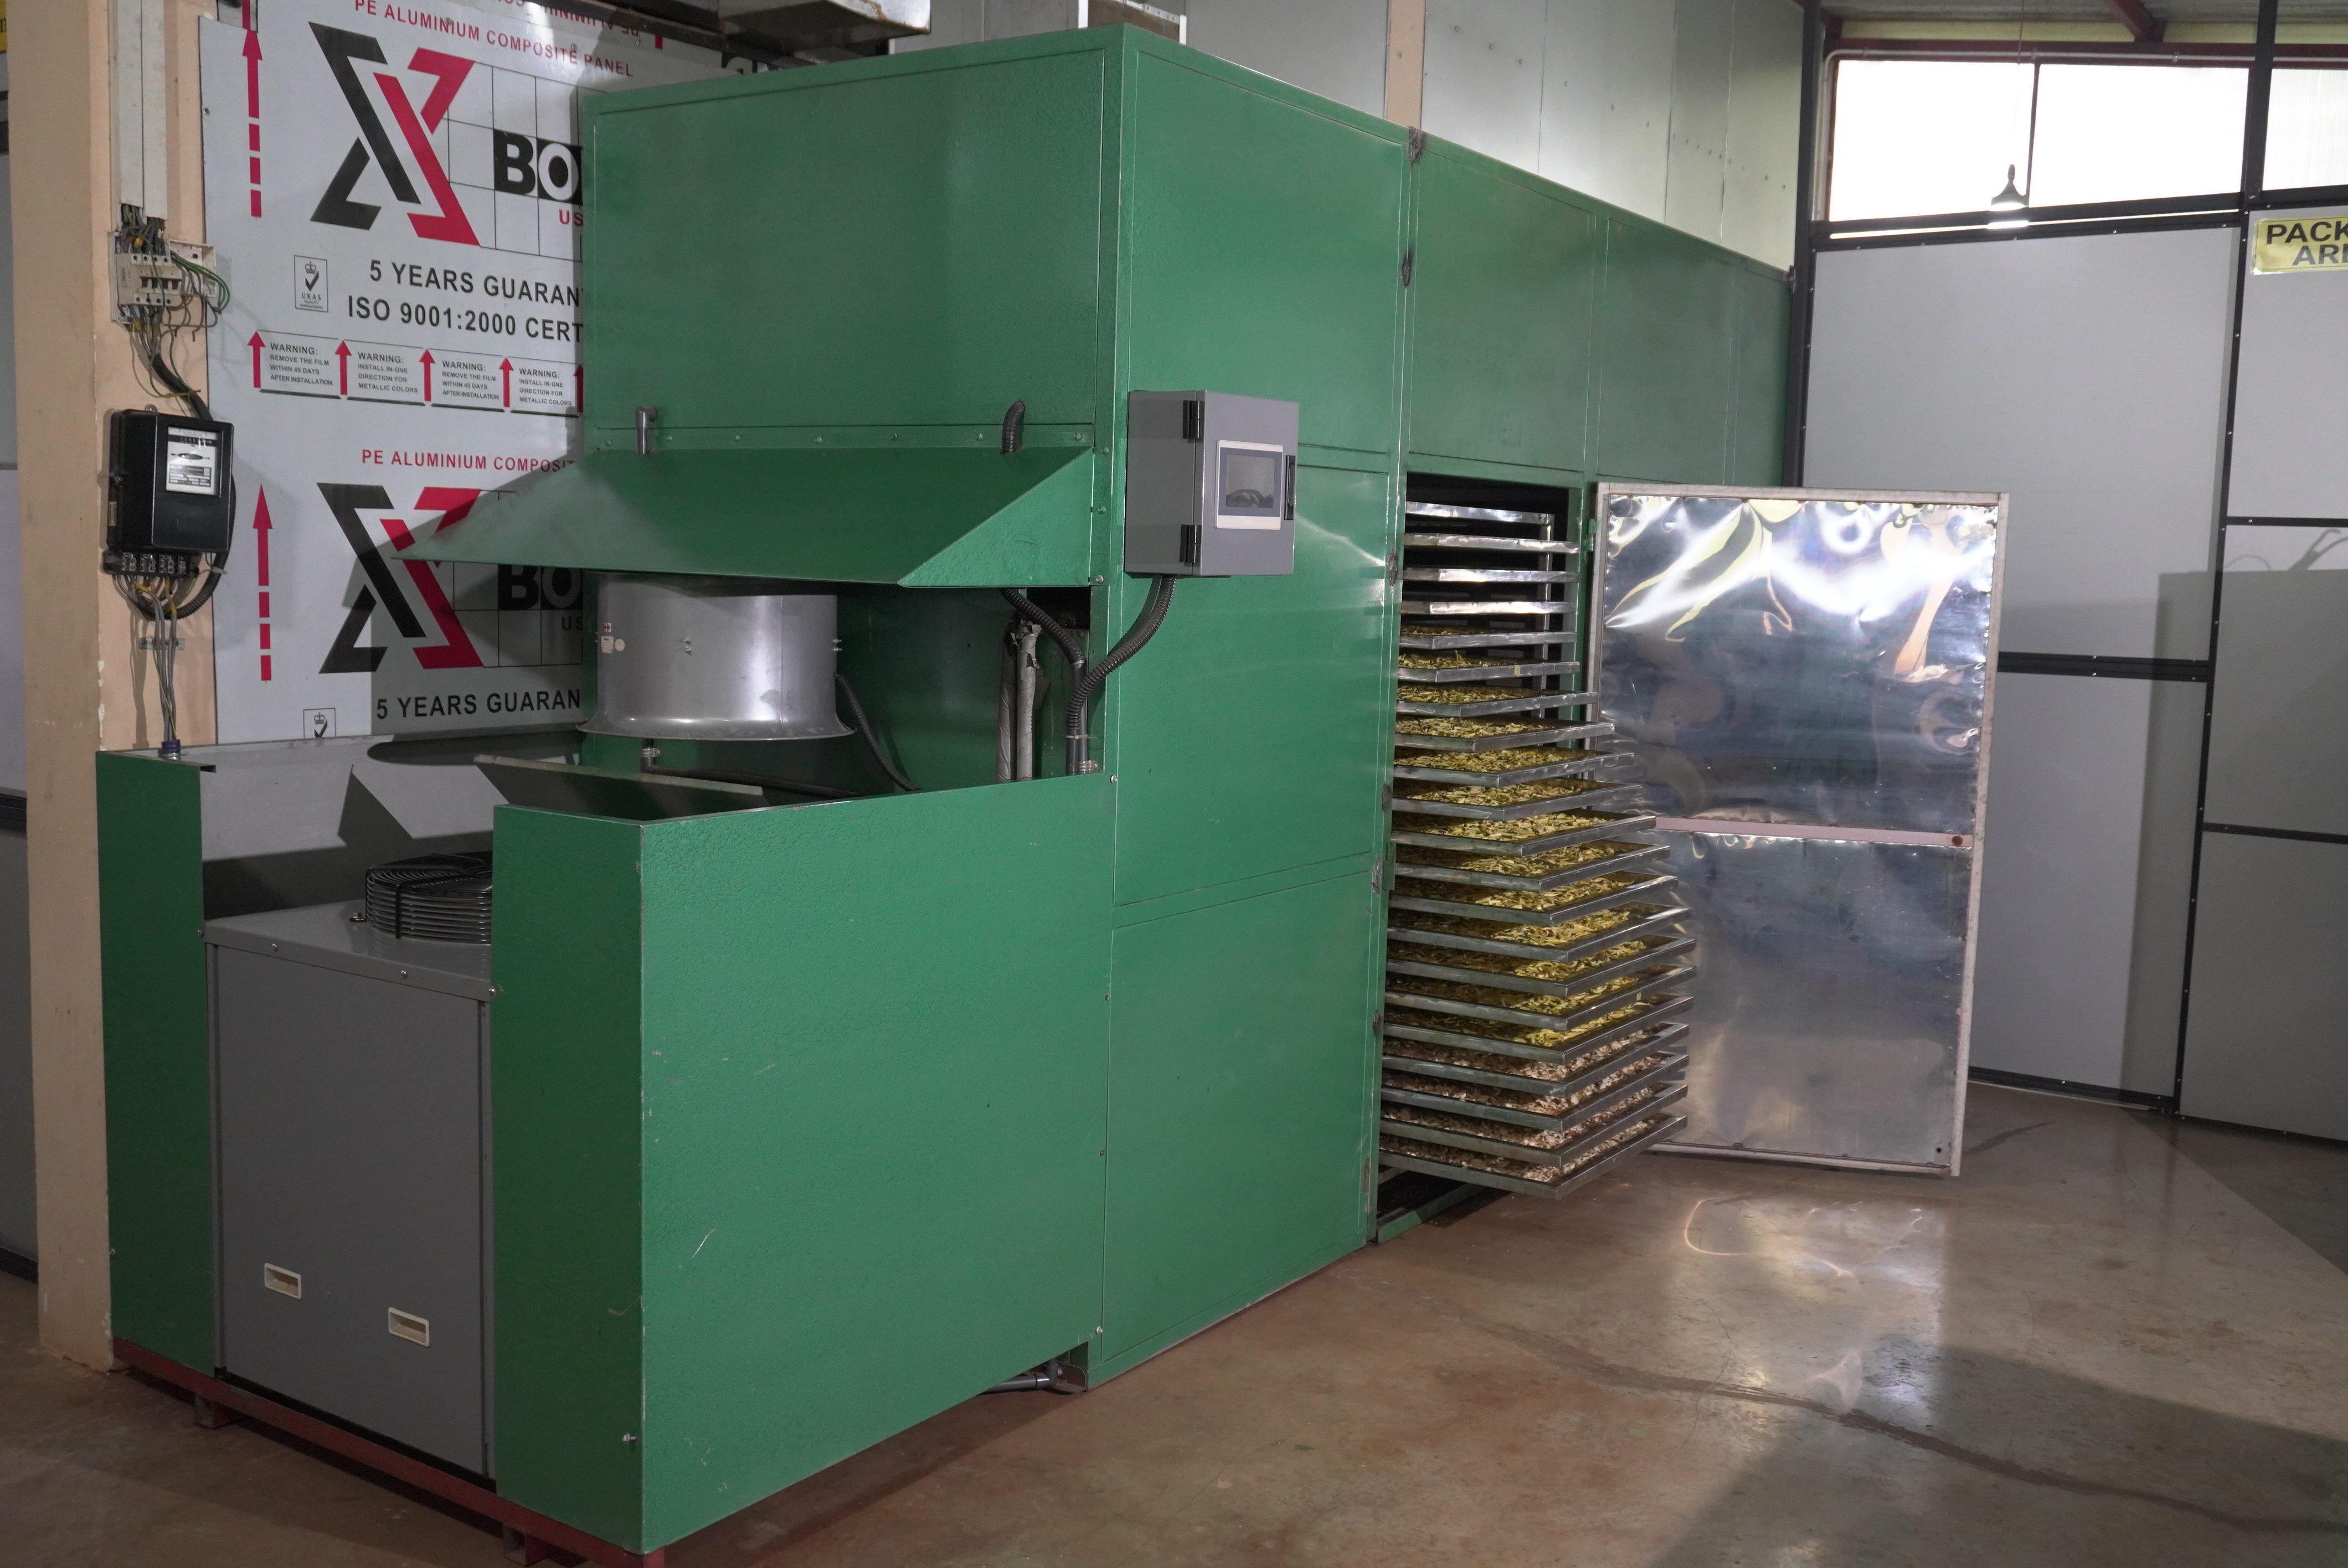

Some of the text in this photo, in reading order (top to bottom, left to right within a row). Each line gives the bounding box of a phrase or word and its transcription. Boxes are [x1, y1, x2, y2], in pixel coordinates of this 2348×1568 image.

[356, 0, 633, 76] PE ALUMINIUM COMPOSITE PANEL
[369, 259, 583, 307] 5 YEARS GUARAN
[301, 292, 321, 301] UKAS
[348, 295, 583, 342] ISO 9001:2000 CERT
[270, 343, 318, 355] WARNING:
[270, 354, 297, 363] REMOVE
[358, 352, 404, 363] WARNING:
[358, 363, 384, 372] INSTALL
[442, 360, 486, 372] WARNING:
[358, 373, 392, 381] DIRECTION
[519, 368, 560, 379] WARNING:
[291, 376, 333, 385] INSTALLATION
[461, 391, 499, 400] INSTALLATION
[362, 449, 383, 464] PE
[391, 451, 486, 470] ALUMINIUM
[376, 689, 580, 719] 5 YEARS GUARAN
